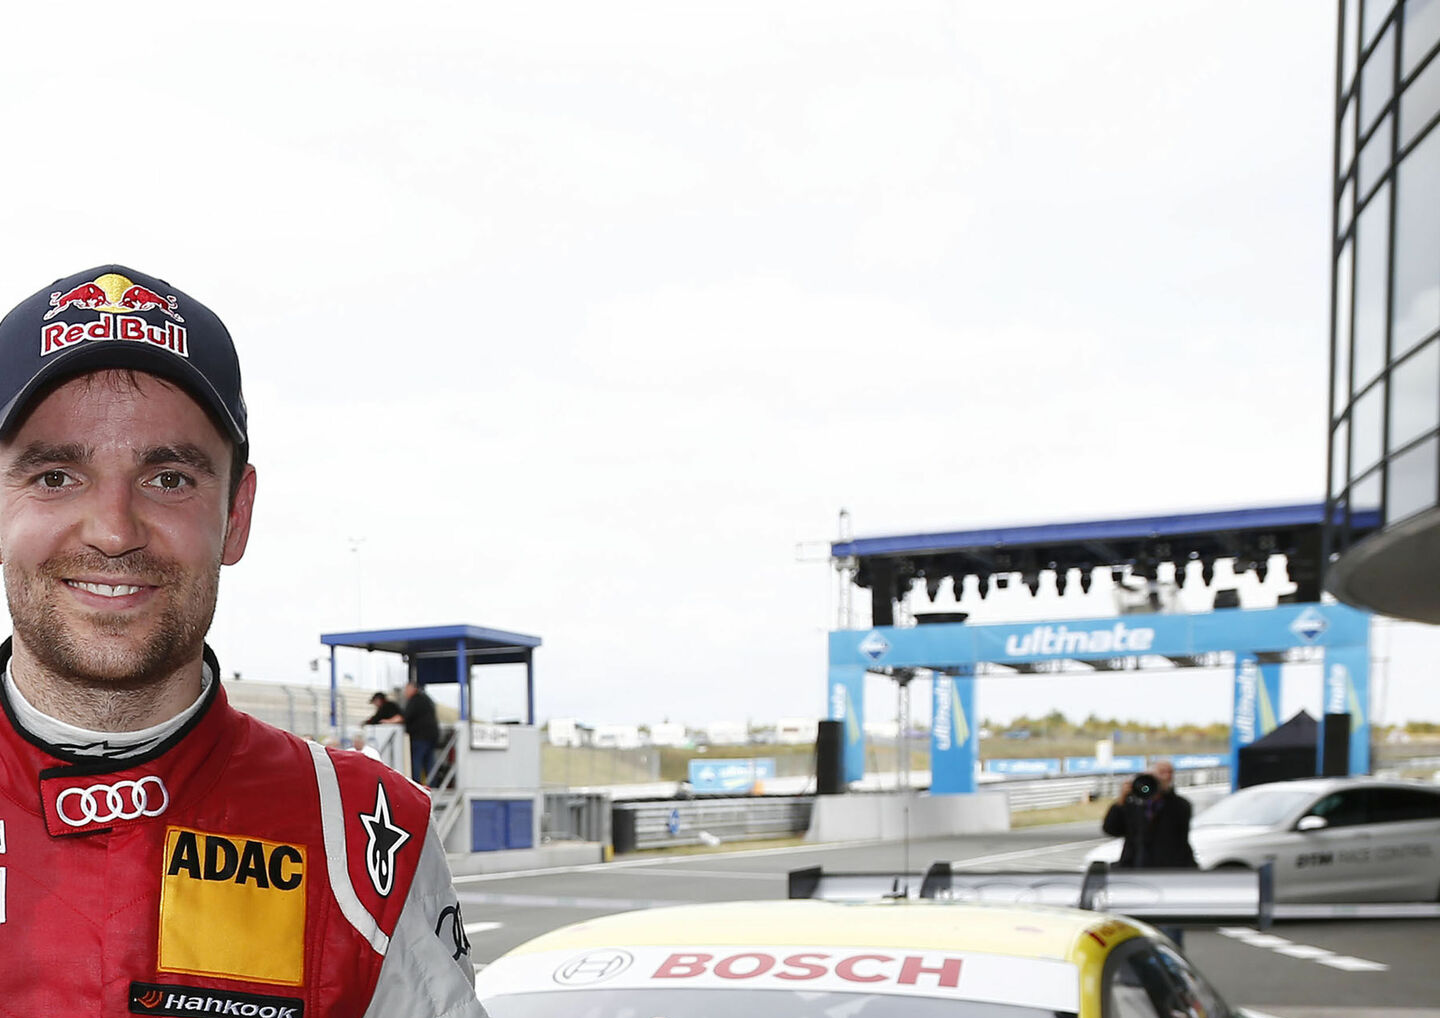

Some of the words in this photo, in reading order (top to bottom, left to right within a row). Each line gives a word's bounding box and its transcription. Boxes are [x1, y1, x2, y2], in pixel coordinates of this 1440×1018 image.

[42, 313, 112, 356] Red
[117, 314, 188, 357] Bull
[1006, 622, 1156, 657] ultimate
[167, 830, 304, 891] ADAC
[651, 952, 964, 989] BOSCH
